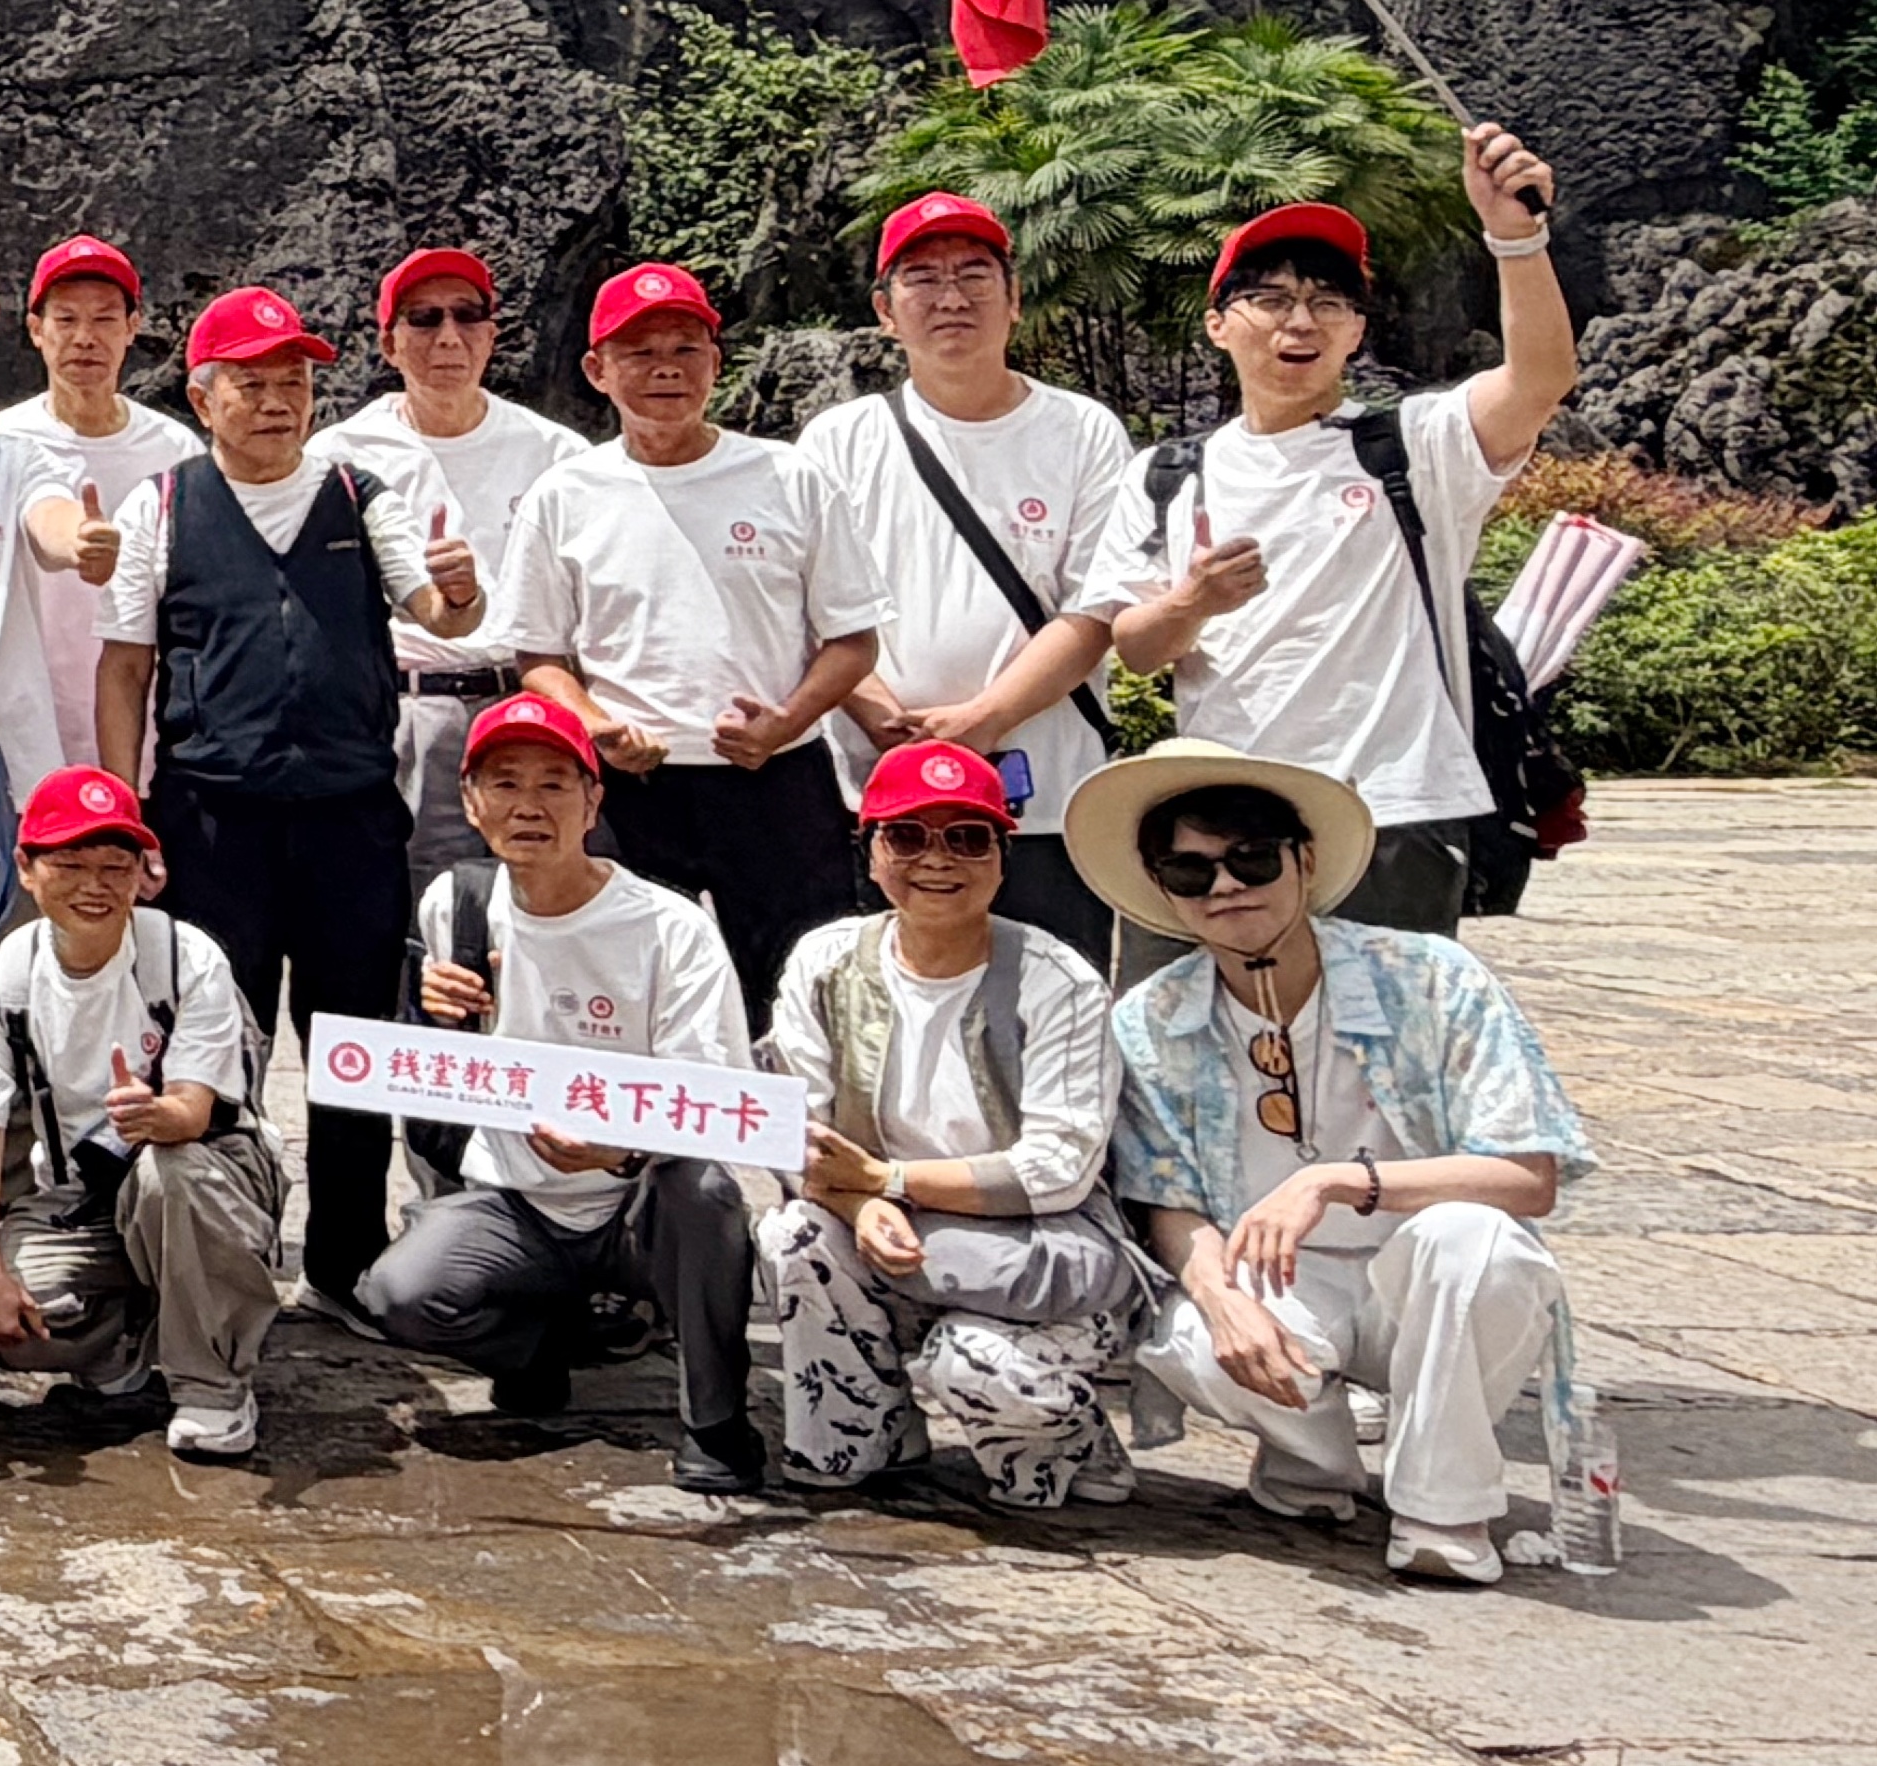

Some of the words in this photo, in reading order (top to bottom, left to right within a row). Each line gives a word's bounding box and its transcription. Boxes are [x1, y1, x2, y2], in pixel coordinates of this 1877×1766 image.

[386, 1047, 536, 1098] 钱堂教育
[564, 1071, 770, 1143] 线下打卡
